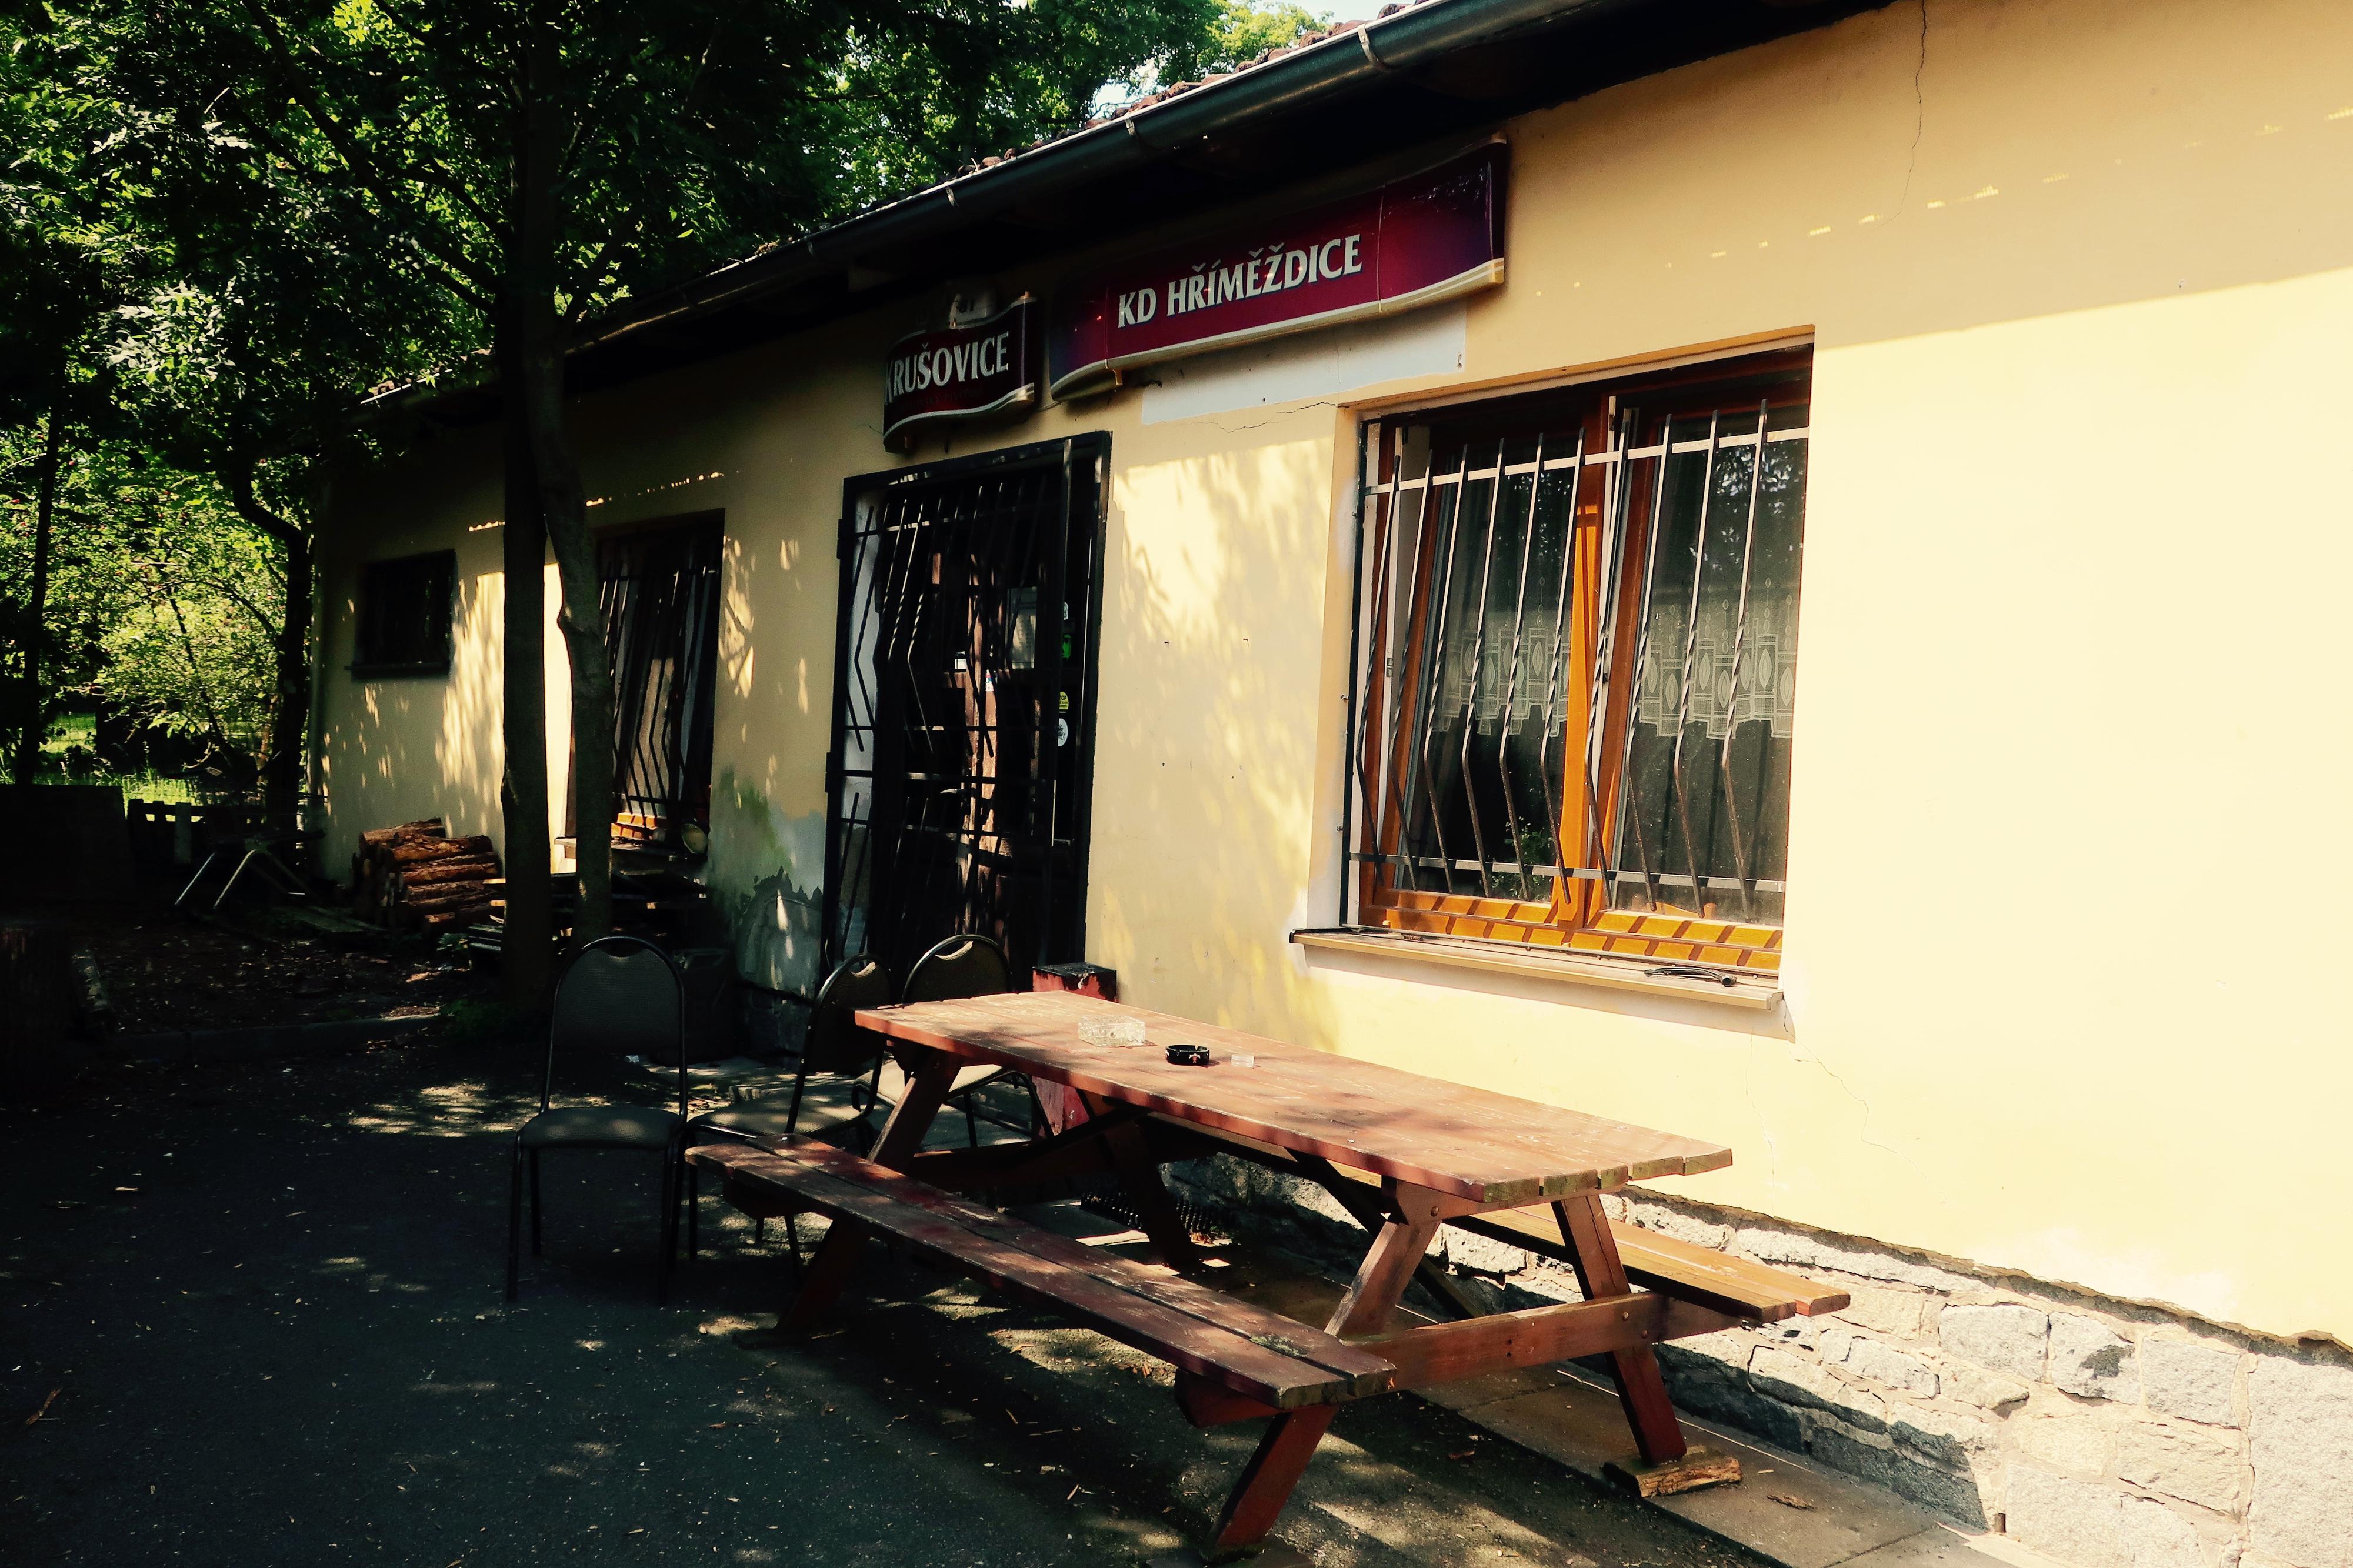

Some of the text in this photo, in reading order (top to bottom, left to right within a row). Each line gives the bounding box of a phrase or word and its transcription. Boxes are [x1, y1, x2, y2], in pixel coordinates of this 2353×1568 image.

[1117, 234, 1362, 328] KD HŘÍMĚŽDICE
[885, 331, 1009, 404] KRUŠOVICE
